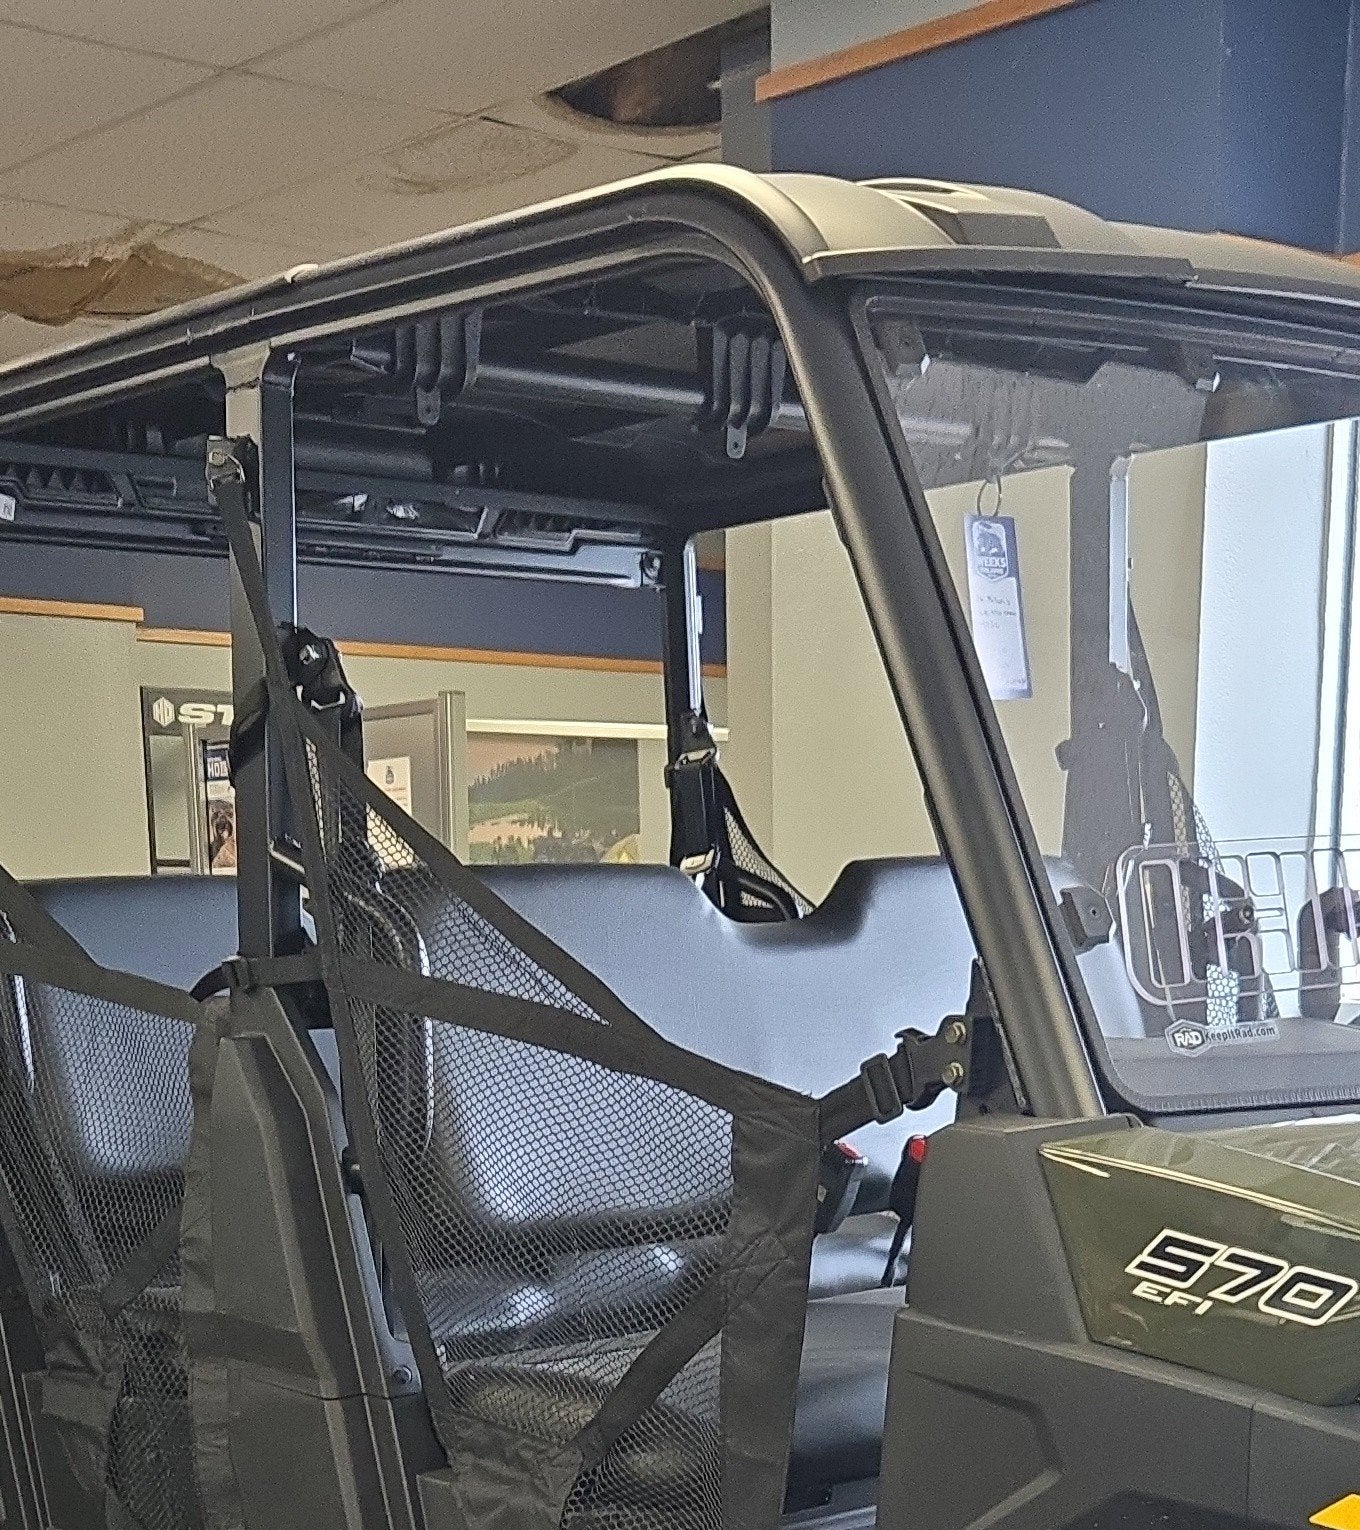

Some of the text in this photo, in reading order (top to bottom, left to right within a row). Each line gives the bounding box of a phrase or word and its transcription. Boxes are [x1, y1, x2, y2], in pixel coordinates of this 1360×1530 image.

[1173, 1030, 1202, 1047] RAD
[1124, 1228, 1360, 1327] 570
[1132, 1283, 1213, 1316] EFI
